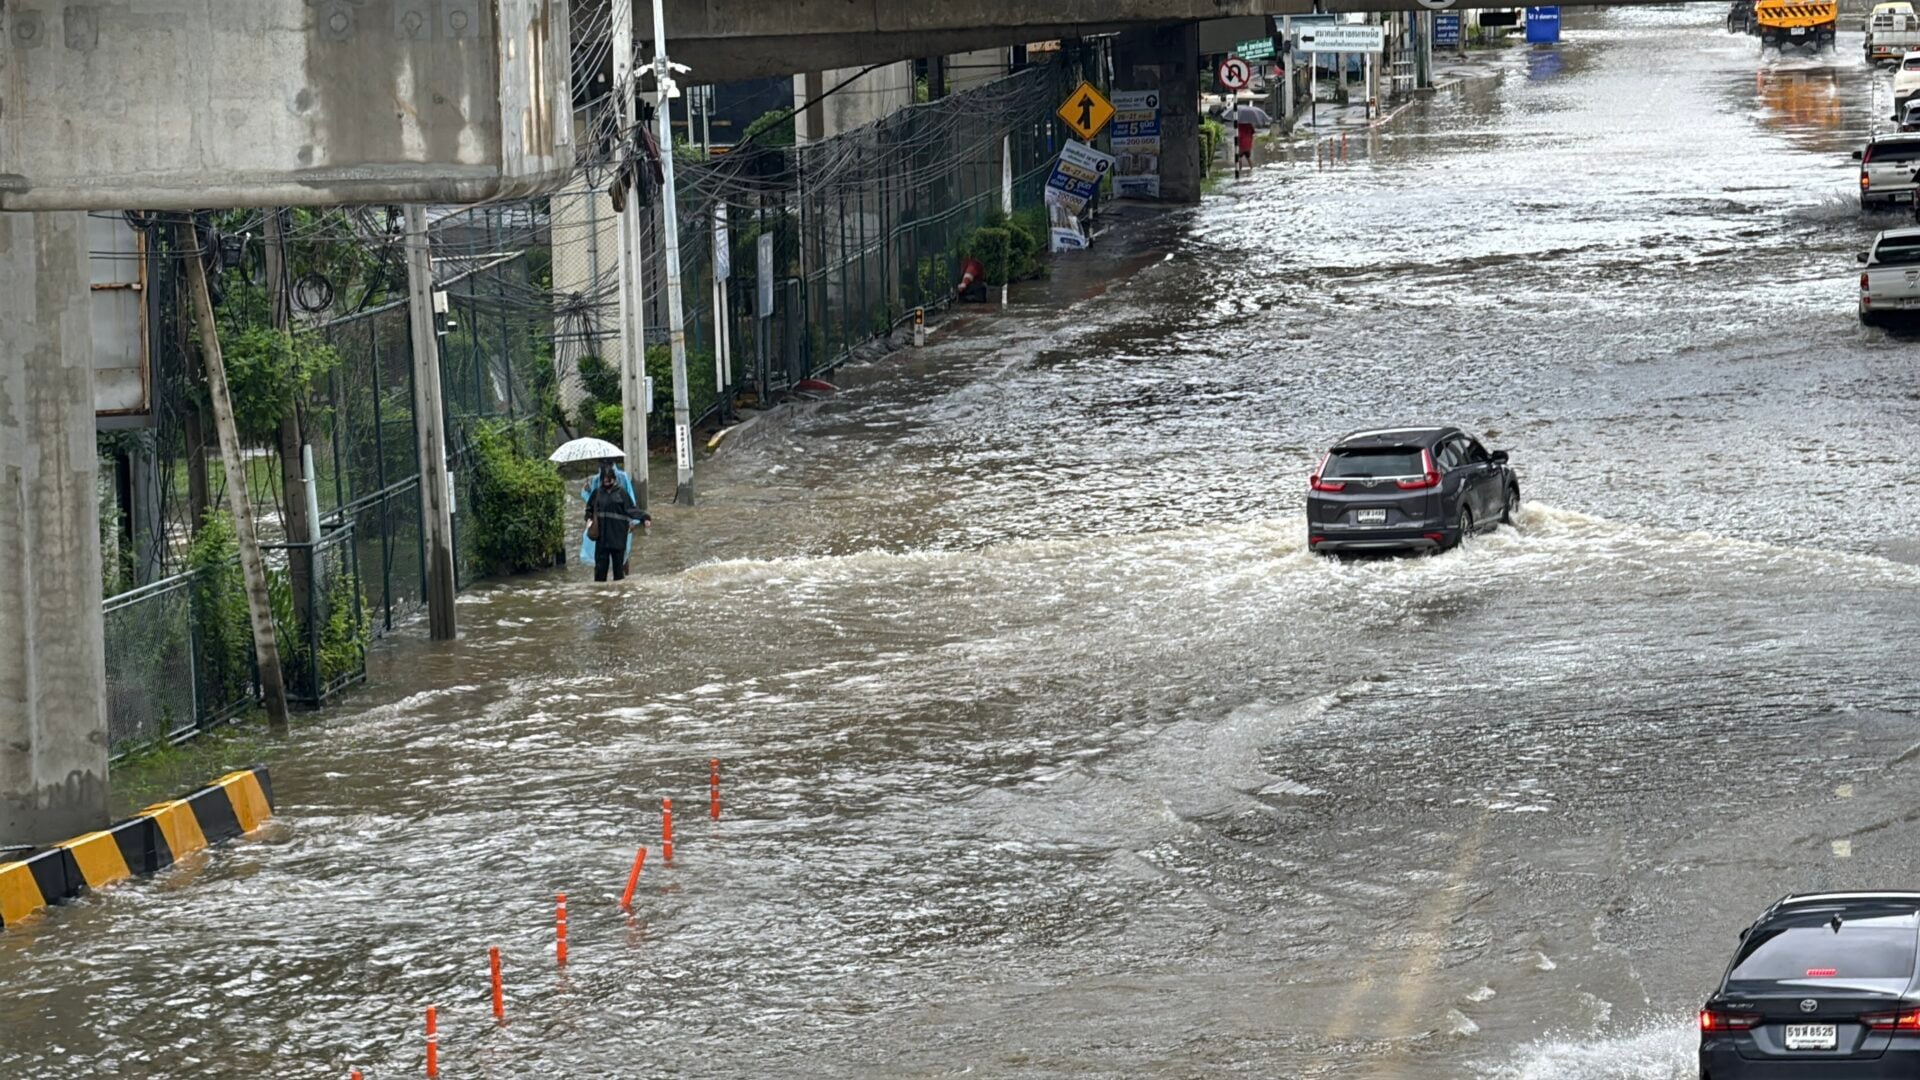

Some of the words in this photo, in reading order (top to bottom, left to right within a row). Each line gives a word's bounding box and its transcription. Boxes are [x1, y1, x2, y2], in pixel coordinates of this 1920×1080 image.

[1129, 122, 1139, 135] 5
[1065, 177, 1075, 192] 5
[1809, 1026, 1834, 1037] 8525
